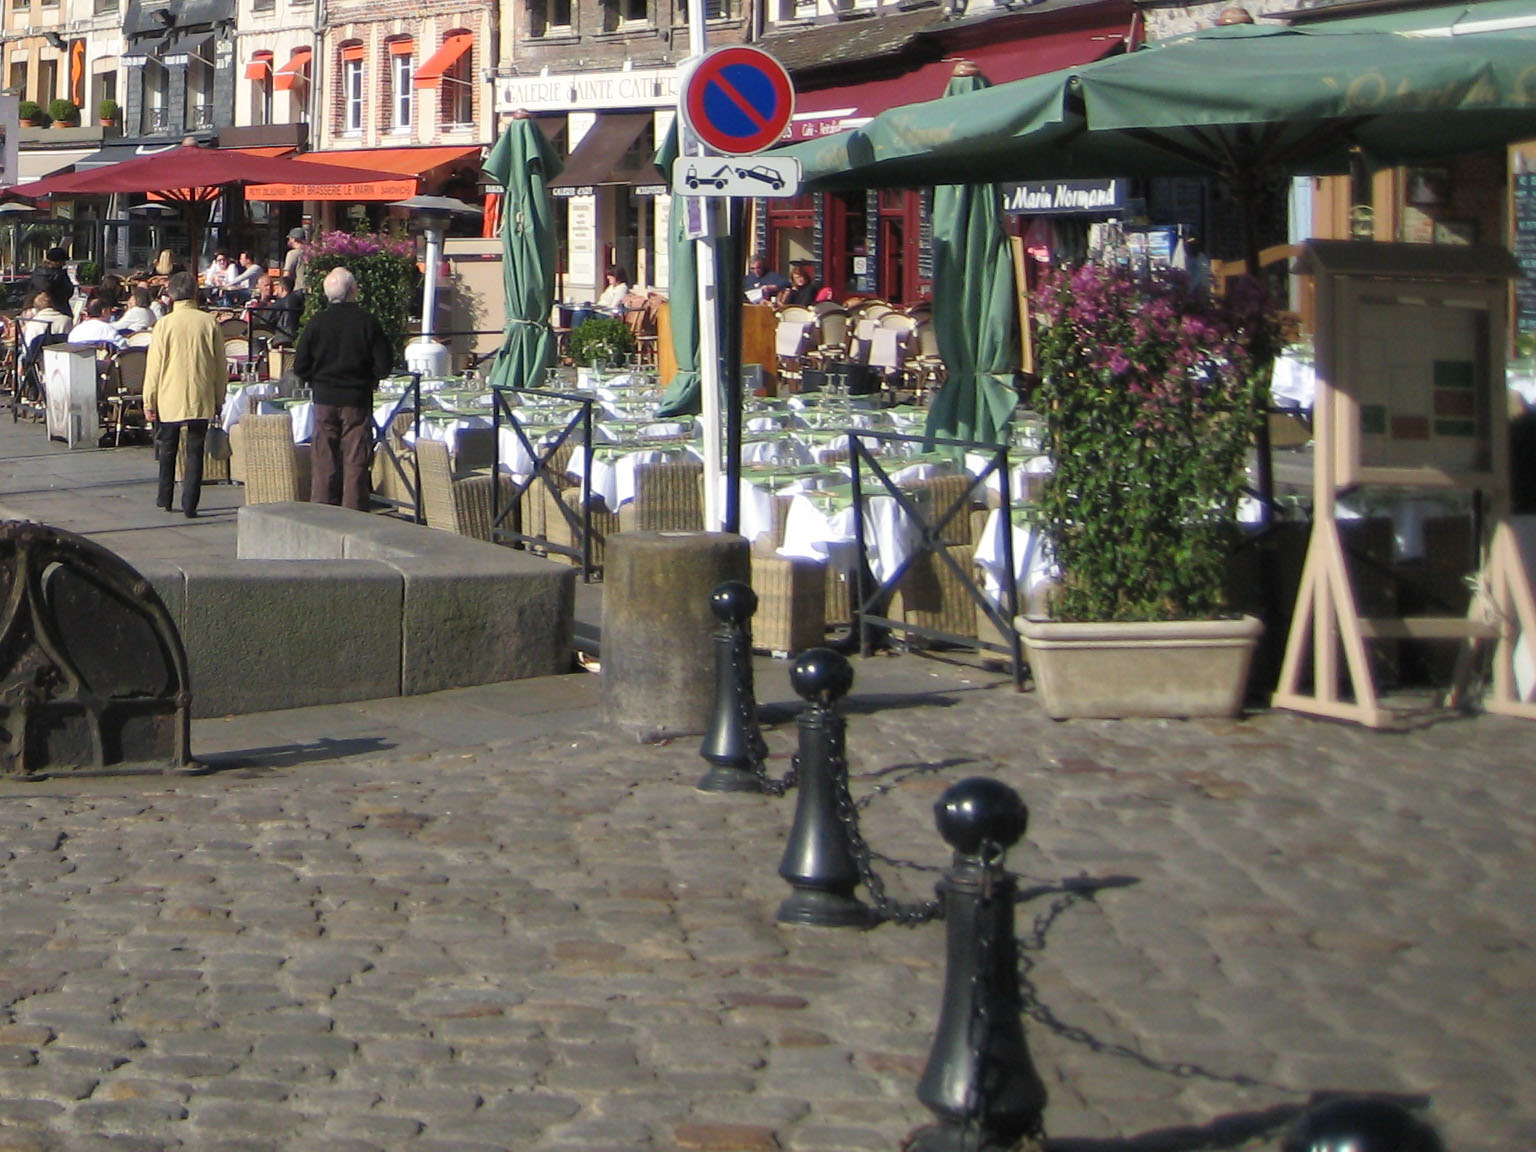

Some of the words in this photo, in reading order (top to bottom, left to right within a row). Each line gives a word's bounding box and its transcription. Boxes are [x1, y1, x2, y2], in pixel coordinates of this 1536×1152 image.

[509, 82, 562, 103] GALERIE
[618, 76, 679, 98] CATHER
[291, 185, 305, 196] BAR
[307, 185, 342, 196] BRASSERIE
[343, 184, 352, 196] LE
[1012, 186, 1052, 210] Marin
[1053, 179, 1116, 209] Normand
